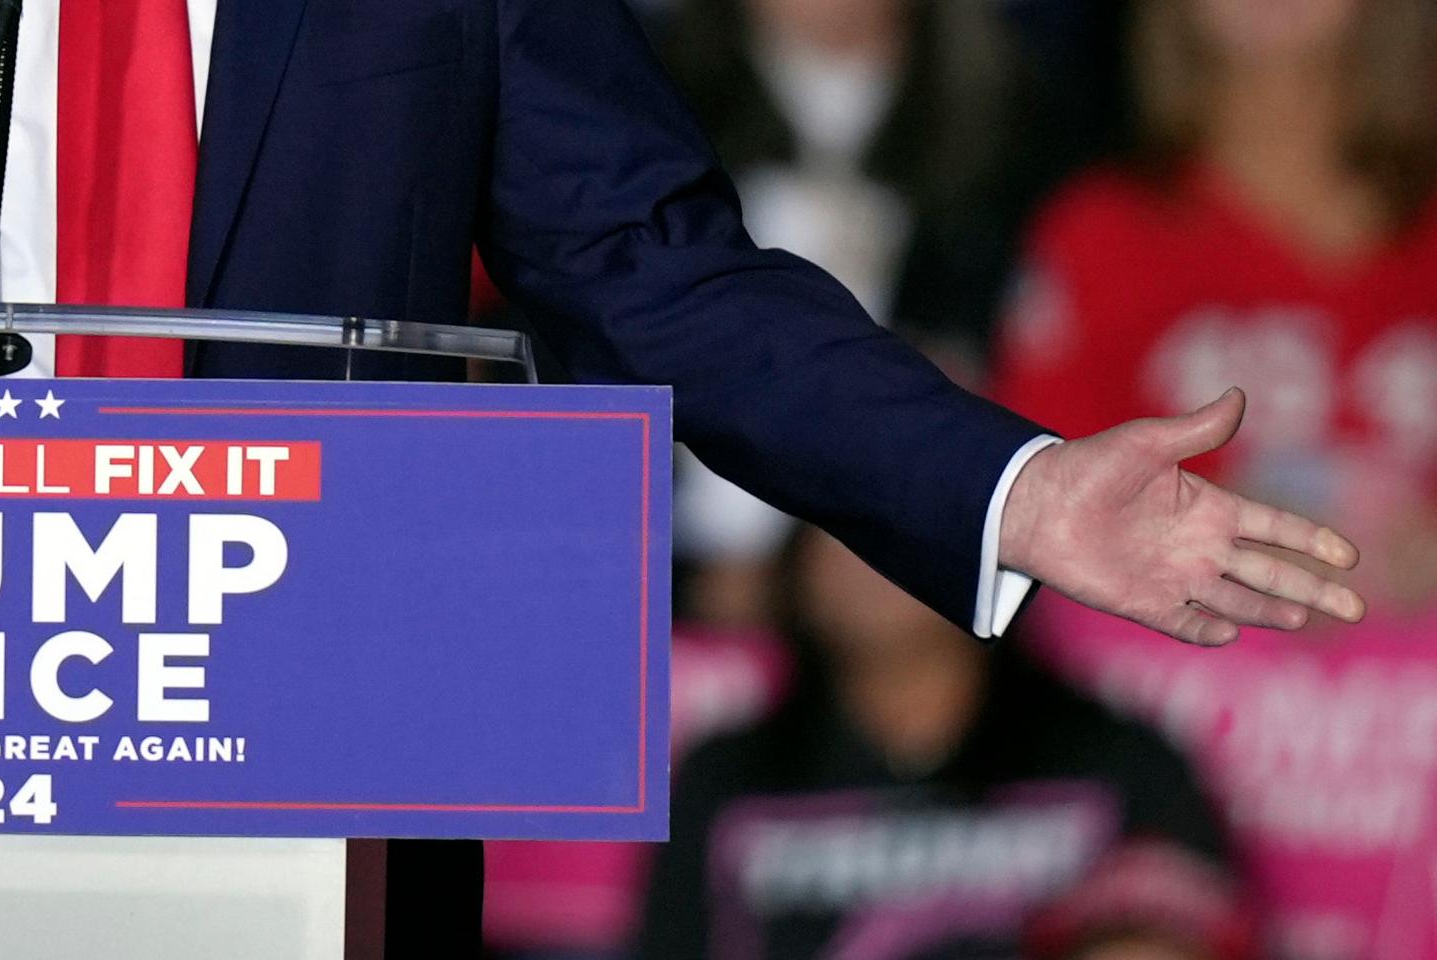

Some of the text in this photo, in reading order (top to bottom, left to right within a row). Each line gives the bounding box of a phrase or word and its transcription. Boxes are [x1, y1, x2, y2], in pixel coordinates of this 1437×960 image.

[94, 445, 205, 495] FIX
[226, 446, 290, 496] IT
[113, 734, 245, 762] AGAIN!
